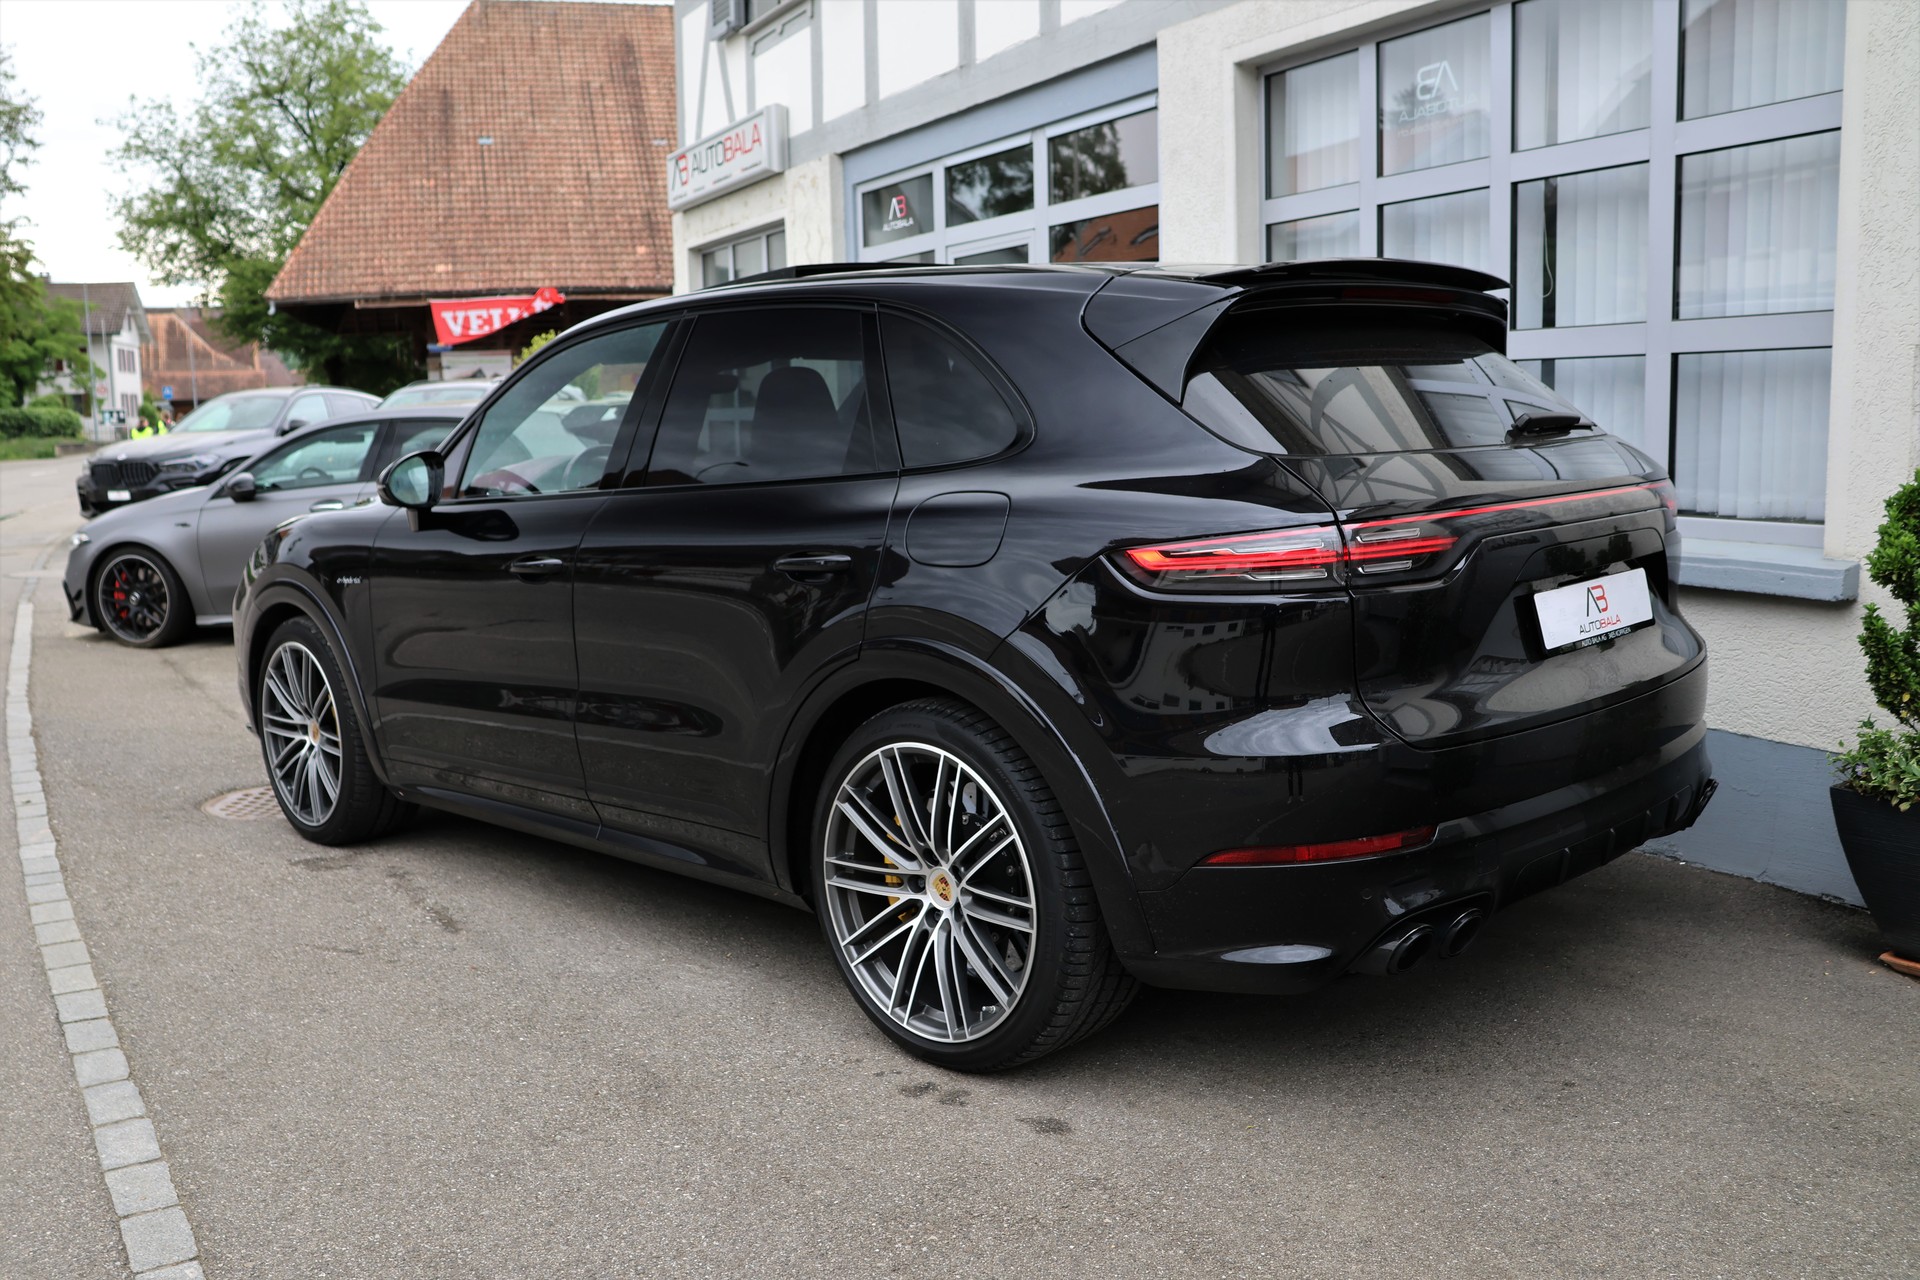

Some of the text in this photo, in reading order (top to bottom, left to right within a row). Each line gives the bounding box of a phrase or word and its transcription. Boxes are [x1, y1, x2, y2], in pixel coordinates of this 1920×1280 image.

[691, 121, 762, 178] AUTOBALA
[882, 217, 914, 231] AUTOBALA
[1579, 614, 1621, 635] AUTOBALA
